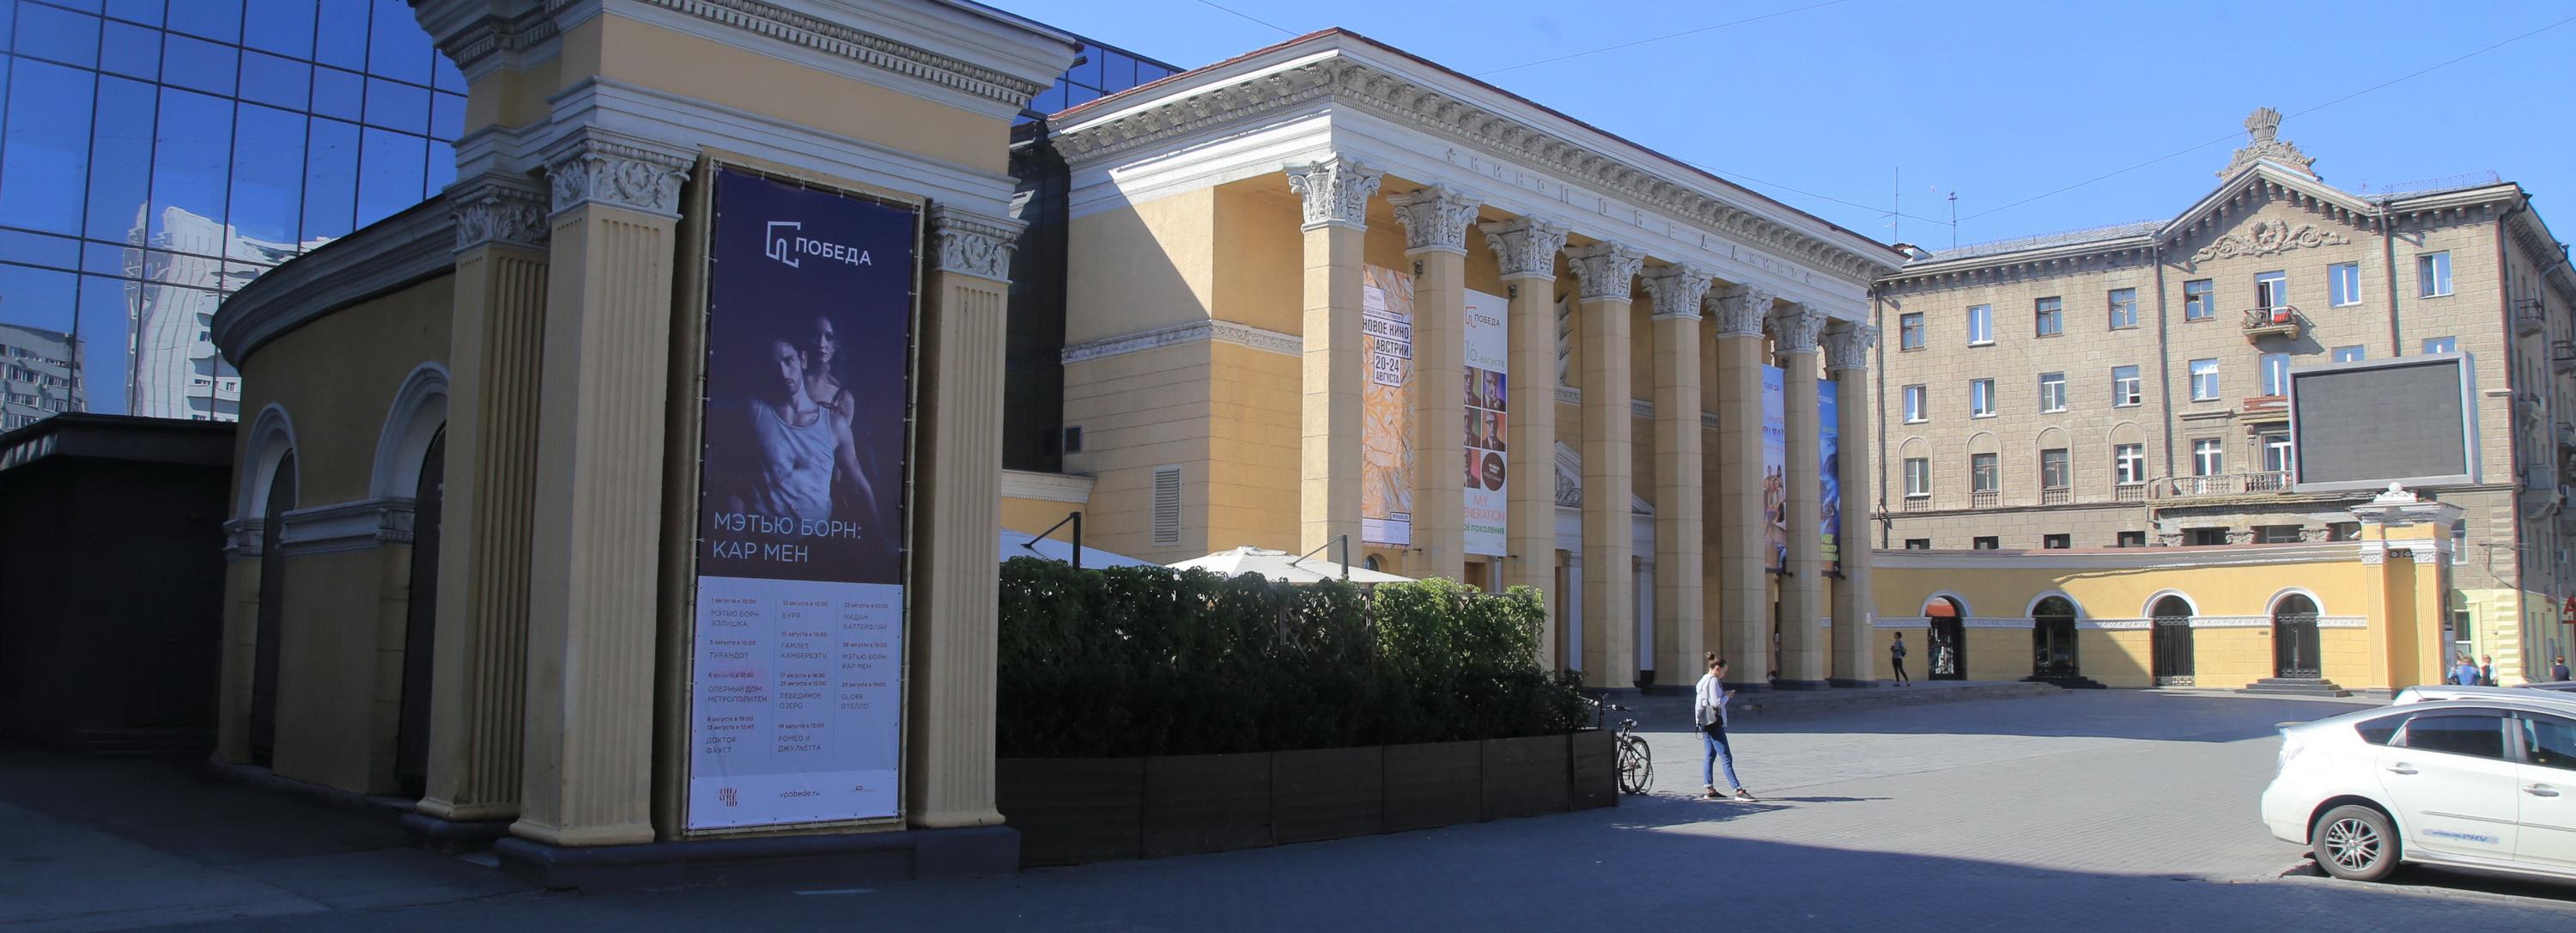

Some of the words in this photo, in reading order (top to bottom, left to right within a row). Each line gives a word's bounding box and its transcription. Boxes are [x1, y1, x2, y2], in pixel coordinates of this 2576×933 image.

[795, 235, 872, 266] ПОБЕДА
[1474, 313, 1501, 326] ПОБЕДА
[1363, 318, 1388, 335] НОВОЕ
[1389, 324, 1409, 339] КИНО
[1376, 338, 1409, 357] АВСТРИИ
[1376, 356, 1399, 373] 20-24
[1478, 356, 1505, 368] августа
[1376, 371, 1400, 384] АВГУСТА
[1473, 494, 1489, 506] MY
[1464, 507, 1505, 522] ENERATION
[714, 512, 793, 534] МЭТЬЮ
[801, 518, 861, 540] БОРН:
[1471, 524, 1504, 535] ПОКОЛЕНИЕ
[714, 540, 757, 560] КАР
[764, 543, 808, 563] МЕН
[778, 744, 822, 753] ДЖУЛЬЕТТА
[780, 790, 820, 799] vpobede.ru
